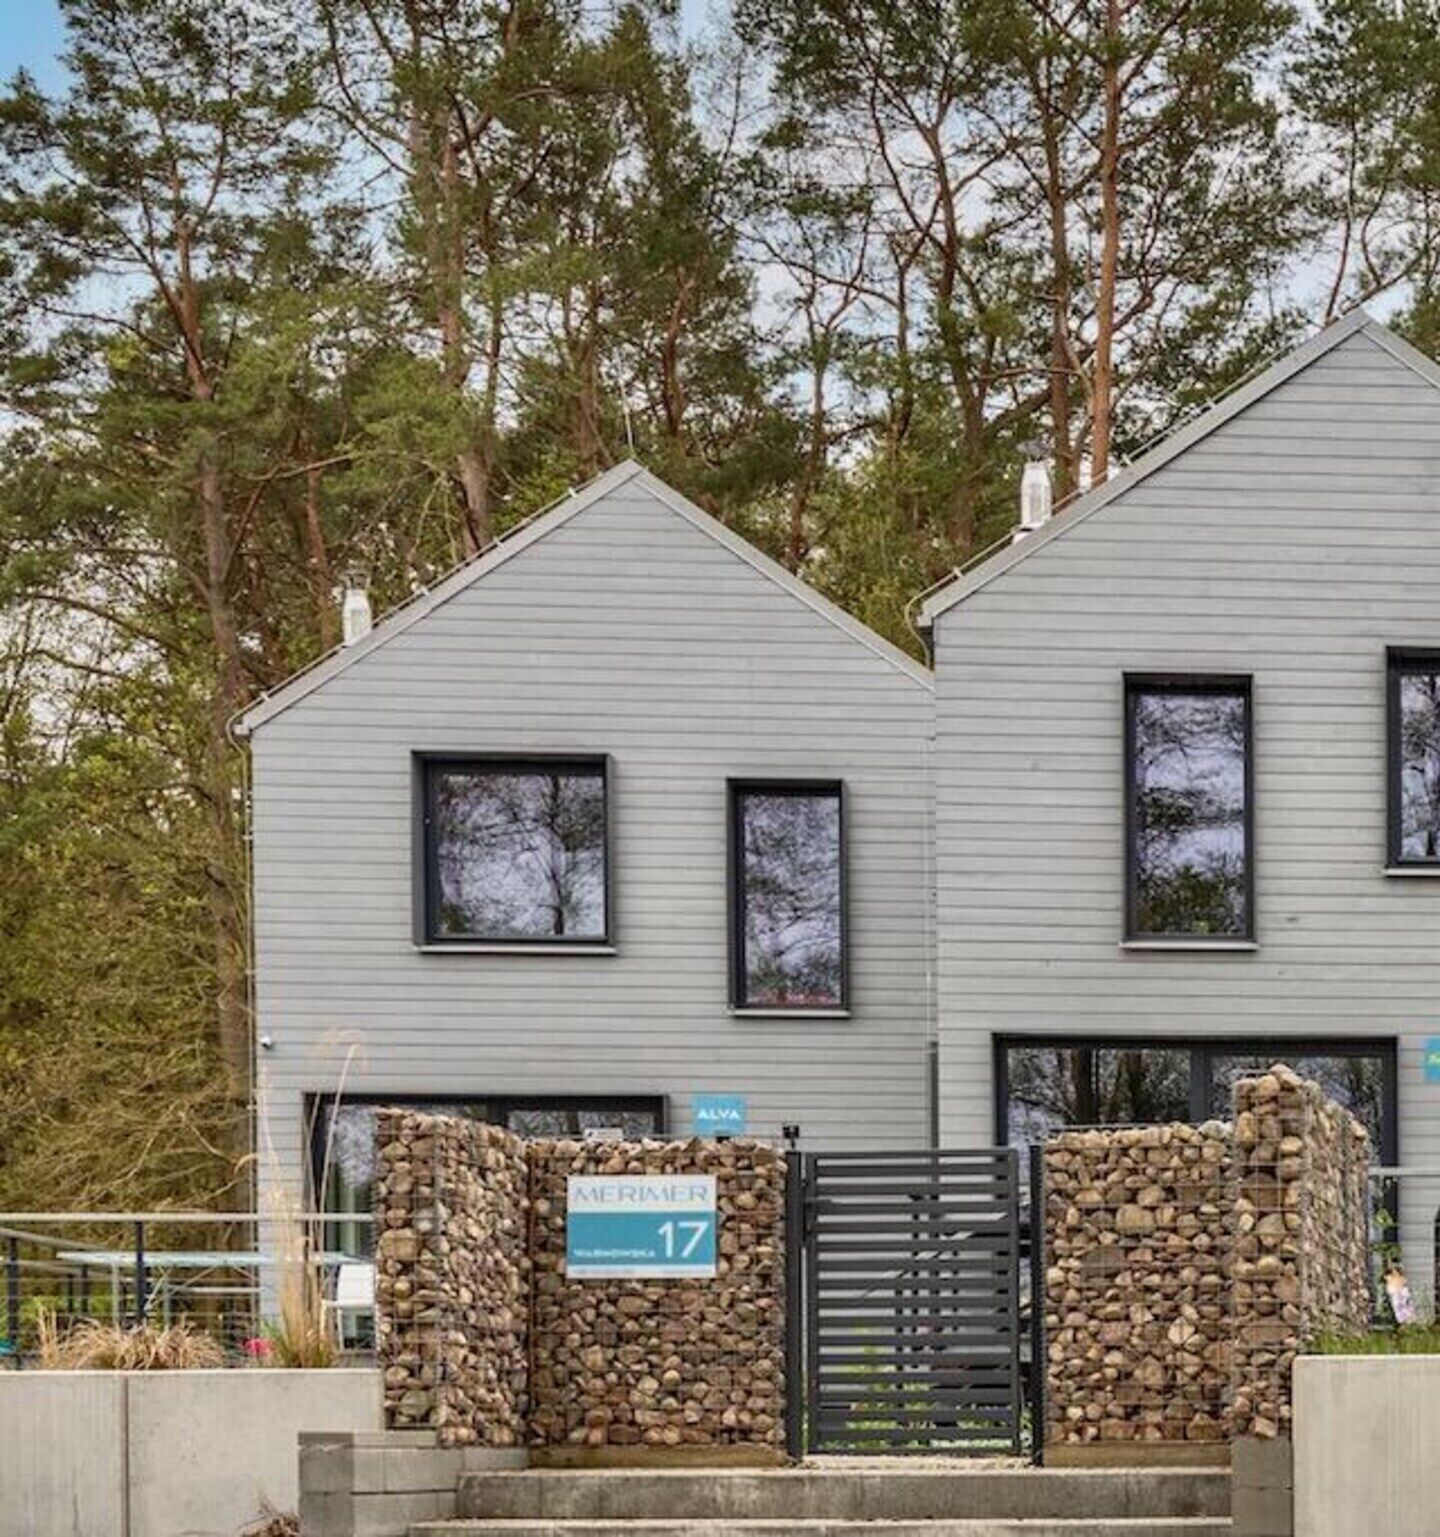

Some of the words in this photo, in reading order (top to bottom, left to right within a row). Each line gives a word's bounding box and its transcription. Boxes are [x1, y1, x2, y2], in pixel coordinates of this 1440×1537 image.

[698, 1108, 742, 1120] ALVA
[574, 1185, 708, 1202] MERIMER
[657, 1220, 710, 1259] 17
